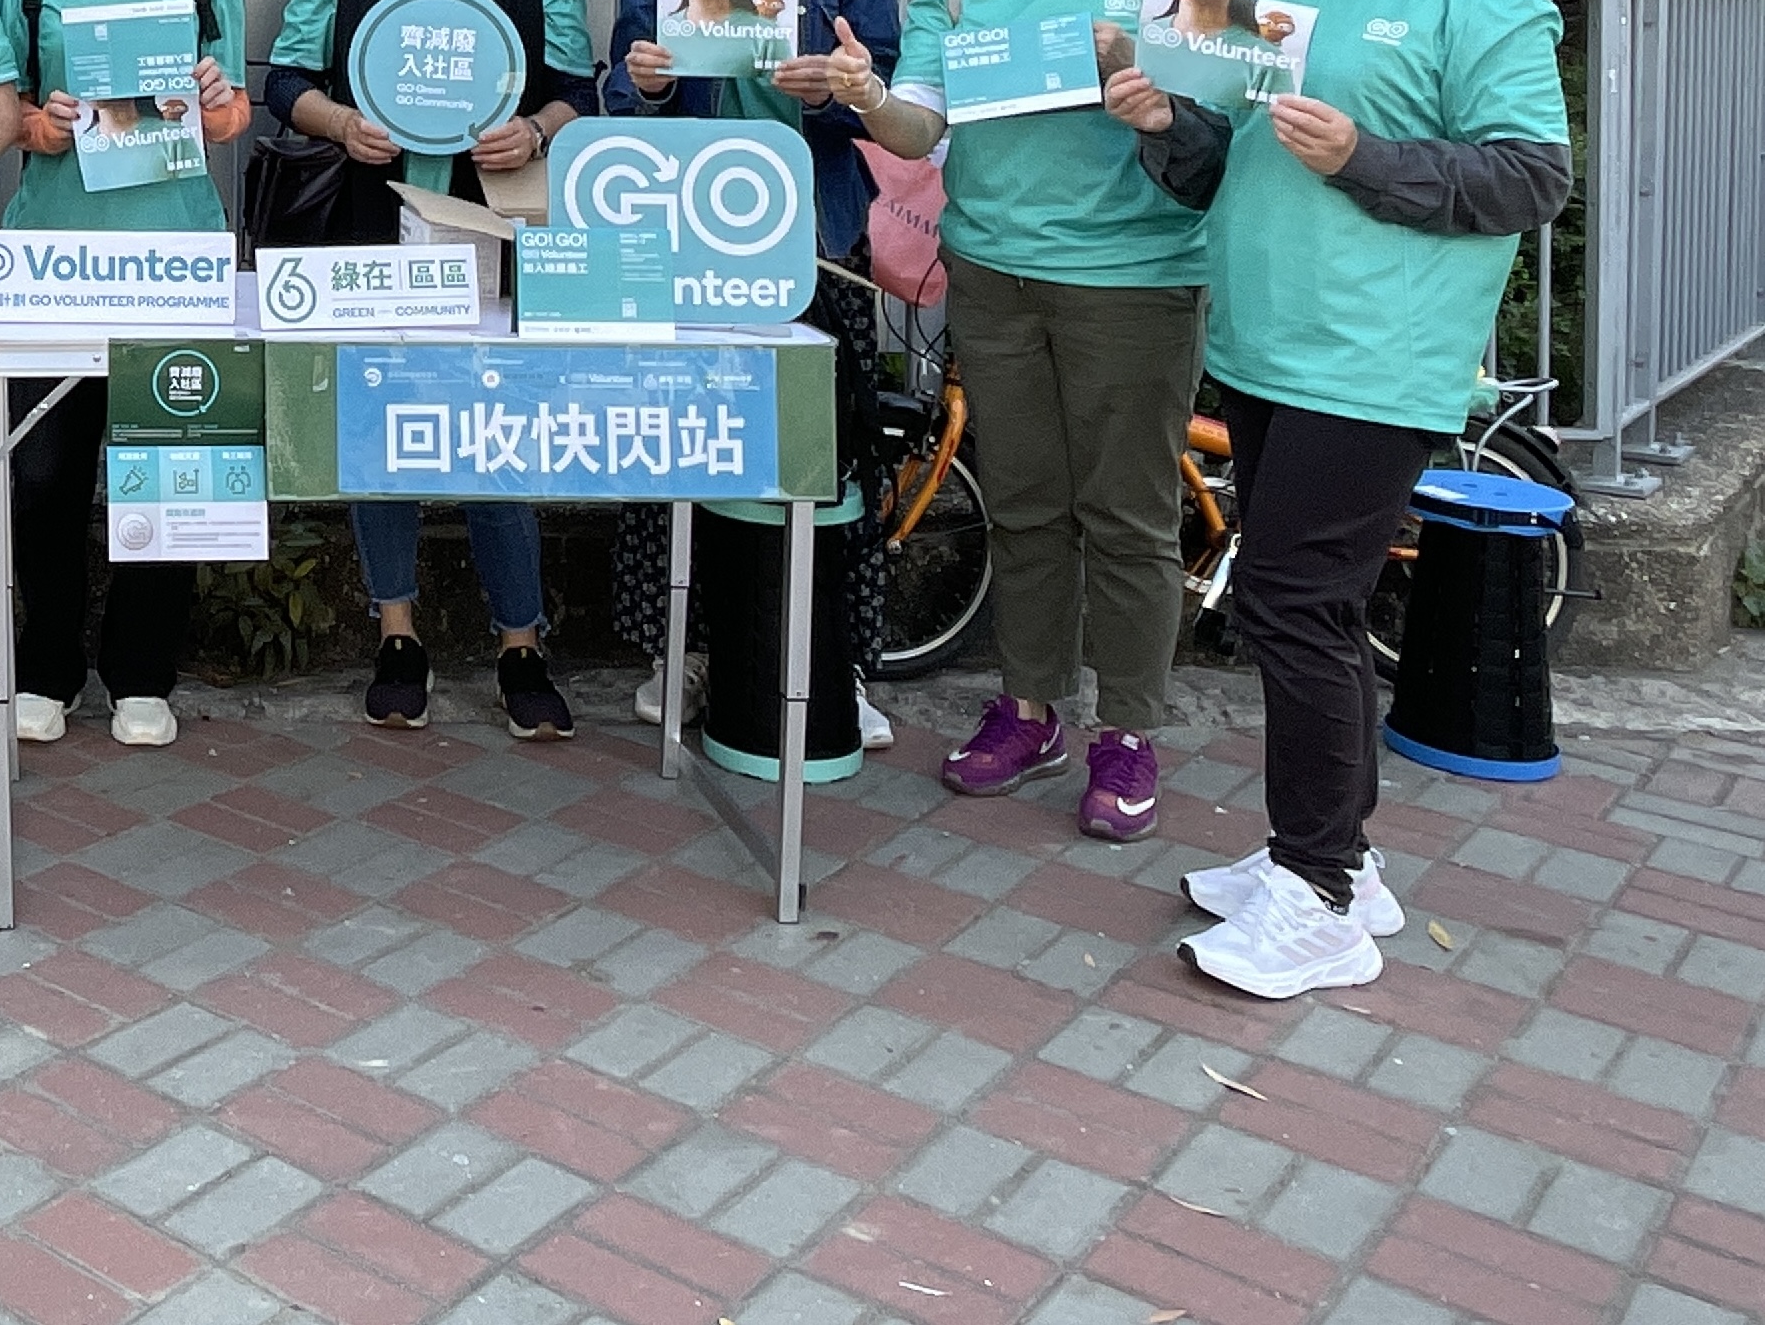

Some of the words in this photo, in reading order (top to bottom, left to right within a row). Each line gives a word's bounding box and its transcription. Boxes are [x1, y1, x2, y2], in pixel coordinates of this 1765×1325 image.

[698, 19, 793, 39] Volunteer
[1186, 30, 1301, 71] Volunteer
[397, 54, 474, 81] 入社區
[415, 95, 475, 112] Community
[111, 125, 198, 149] Volunteer
[564, 135, 798, 257] GO
[22, 244, 232, 283] Volunteer
[28, 294, 52, 307] GO
[54, 294, 135, 308] VOLUNTEER
[137, 295, 230, 309] PROGRAMME
[673, 269, 796, 307] nteer
[332, 307, 375, 318] GREEN
[394, 304, 471, 317] COMMUNITY
[385, 402, 745, 476] 回收快閃站
